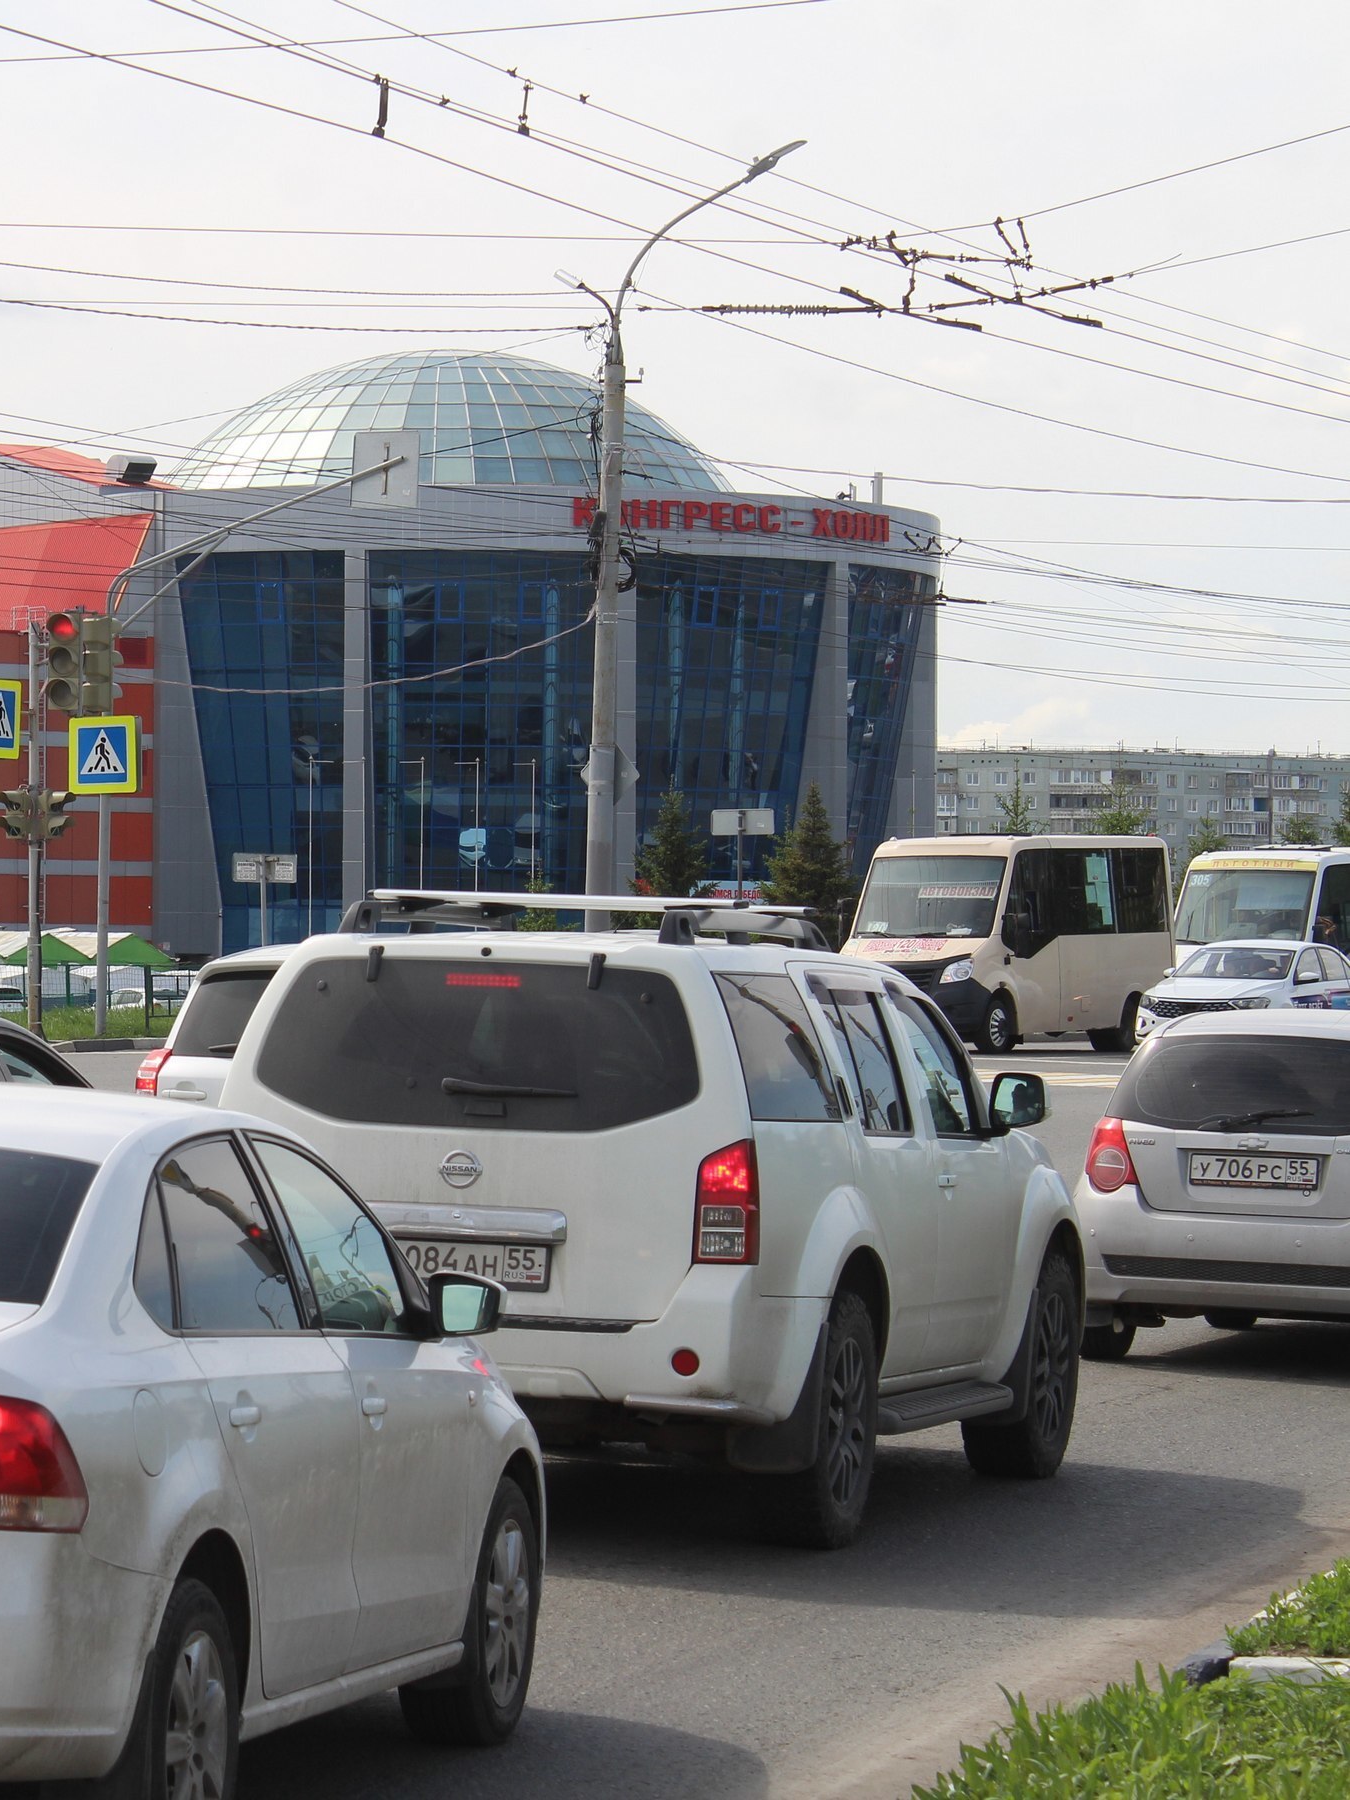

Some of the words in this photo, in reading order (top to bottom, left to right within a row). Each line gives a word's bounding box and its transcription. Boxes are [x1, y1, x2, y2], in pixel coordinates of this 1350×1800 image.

[572, 496, 782, 533] КНГРЕСС
[811, 507, 890, 542] ХОЛЛ
[1212, 859, 1295, 868] ЛЬГОТНЫЙ
[1190, 874, 1210, 886] 305
[919, 886, 996, 897] АВТОВОКЗАЛ
[441, 1164, 479, 1174] NISSAN
[1288, 1160, 1309, 1176] 55
[1287, 1175, 1302, 1183] RUS
[507, 1248, 536, 1271] 55
[504, 1270, 526, 1280] RUS
